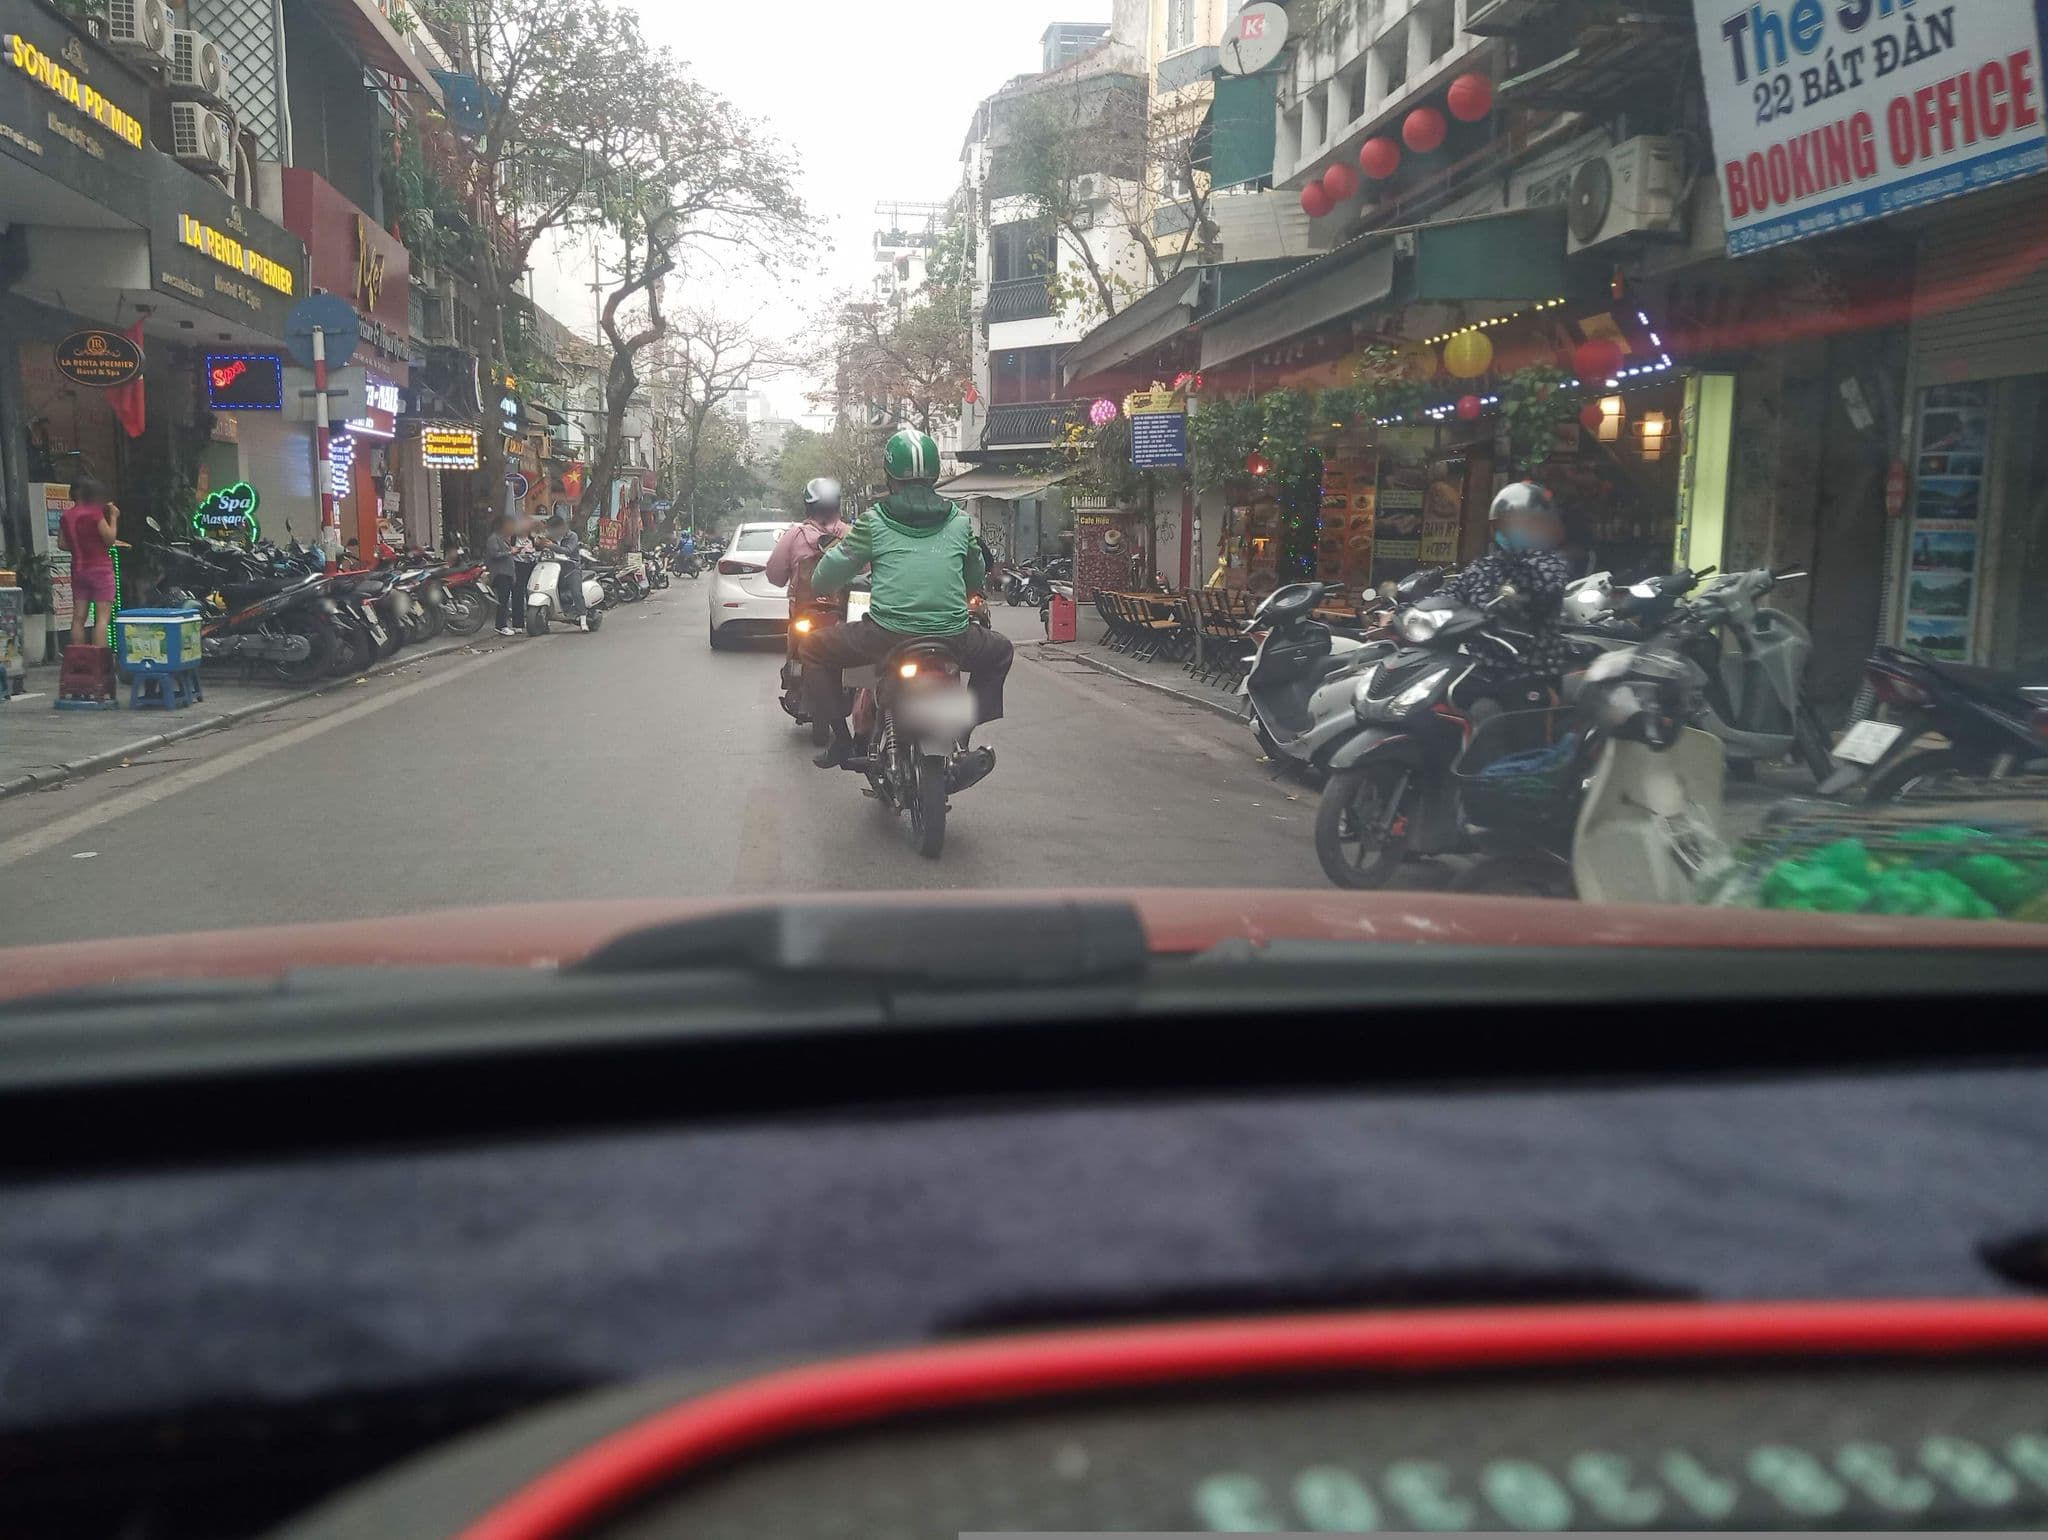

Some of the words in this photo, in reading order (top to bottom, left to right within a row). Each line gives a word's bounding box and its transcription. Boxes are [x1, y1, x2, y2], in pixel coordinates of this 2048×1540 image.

[1722, 0, 1825, 87] The
[1754, 73, 1794, 125] 22
[1800, 47, 1865, 107] BÁT
[1873, 7, 1957, 79] ĐÀN
[11, 34, 82, 108] SONATA
[84, 84, 144, 151] PRMIER
[1725, 110, 1879, 220] BOOKING
[1887, 49, 2039, 169] OFFICE
[181, 213, 203, 251] LA
[206, 226, 244, 272] RENTA
[248, 249, 294, 297] PREMIER
[99, 360, 134, 369] PREMIER
[426, 444, 474, 455] Restaurant
[218, 495, 251, 513] Spa
